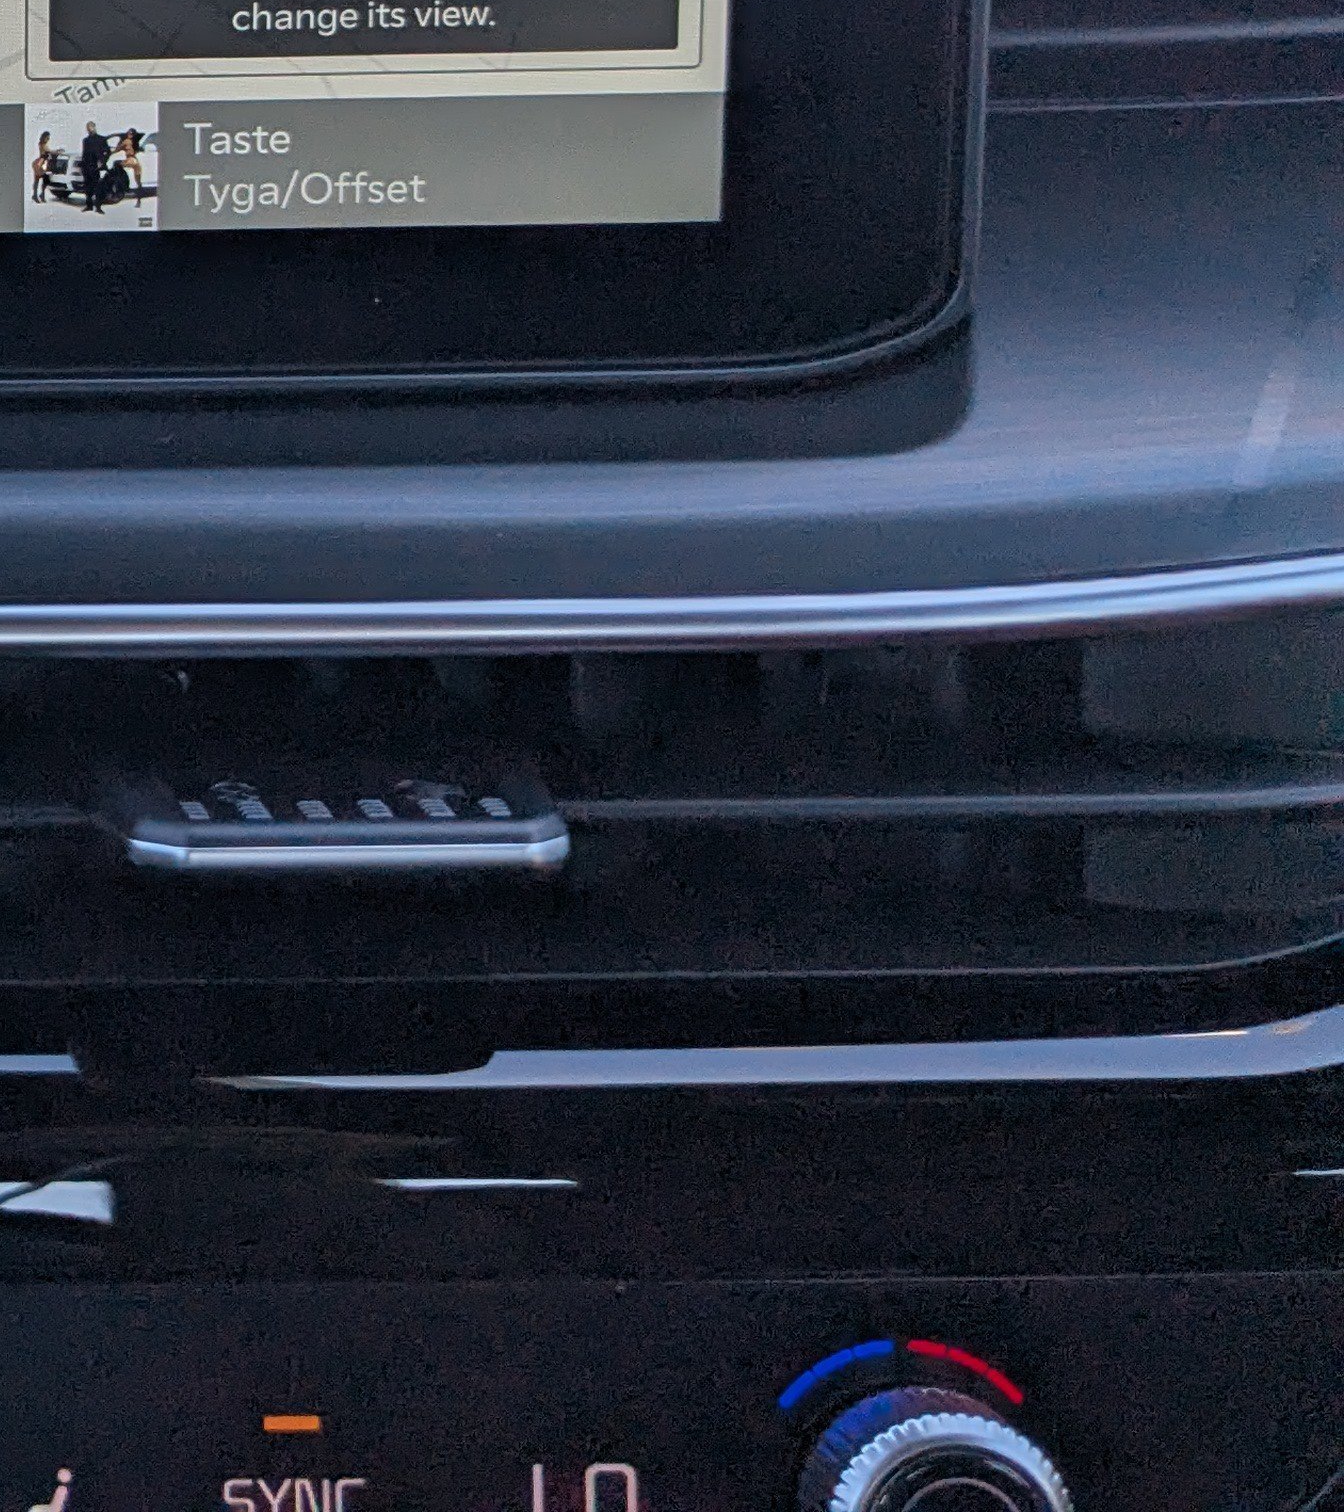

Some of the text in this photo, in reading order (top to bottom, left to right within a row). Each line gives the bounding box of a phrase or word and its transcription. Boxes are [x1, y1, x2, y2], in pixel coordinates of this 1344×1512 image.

[231, 0, 497, 37] change its view.
[183, 123, 291, 157] Taste
[183, 172, 427, 214] Tyga/Offset
